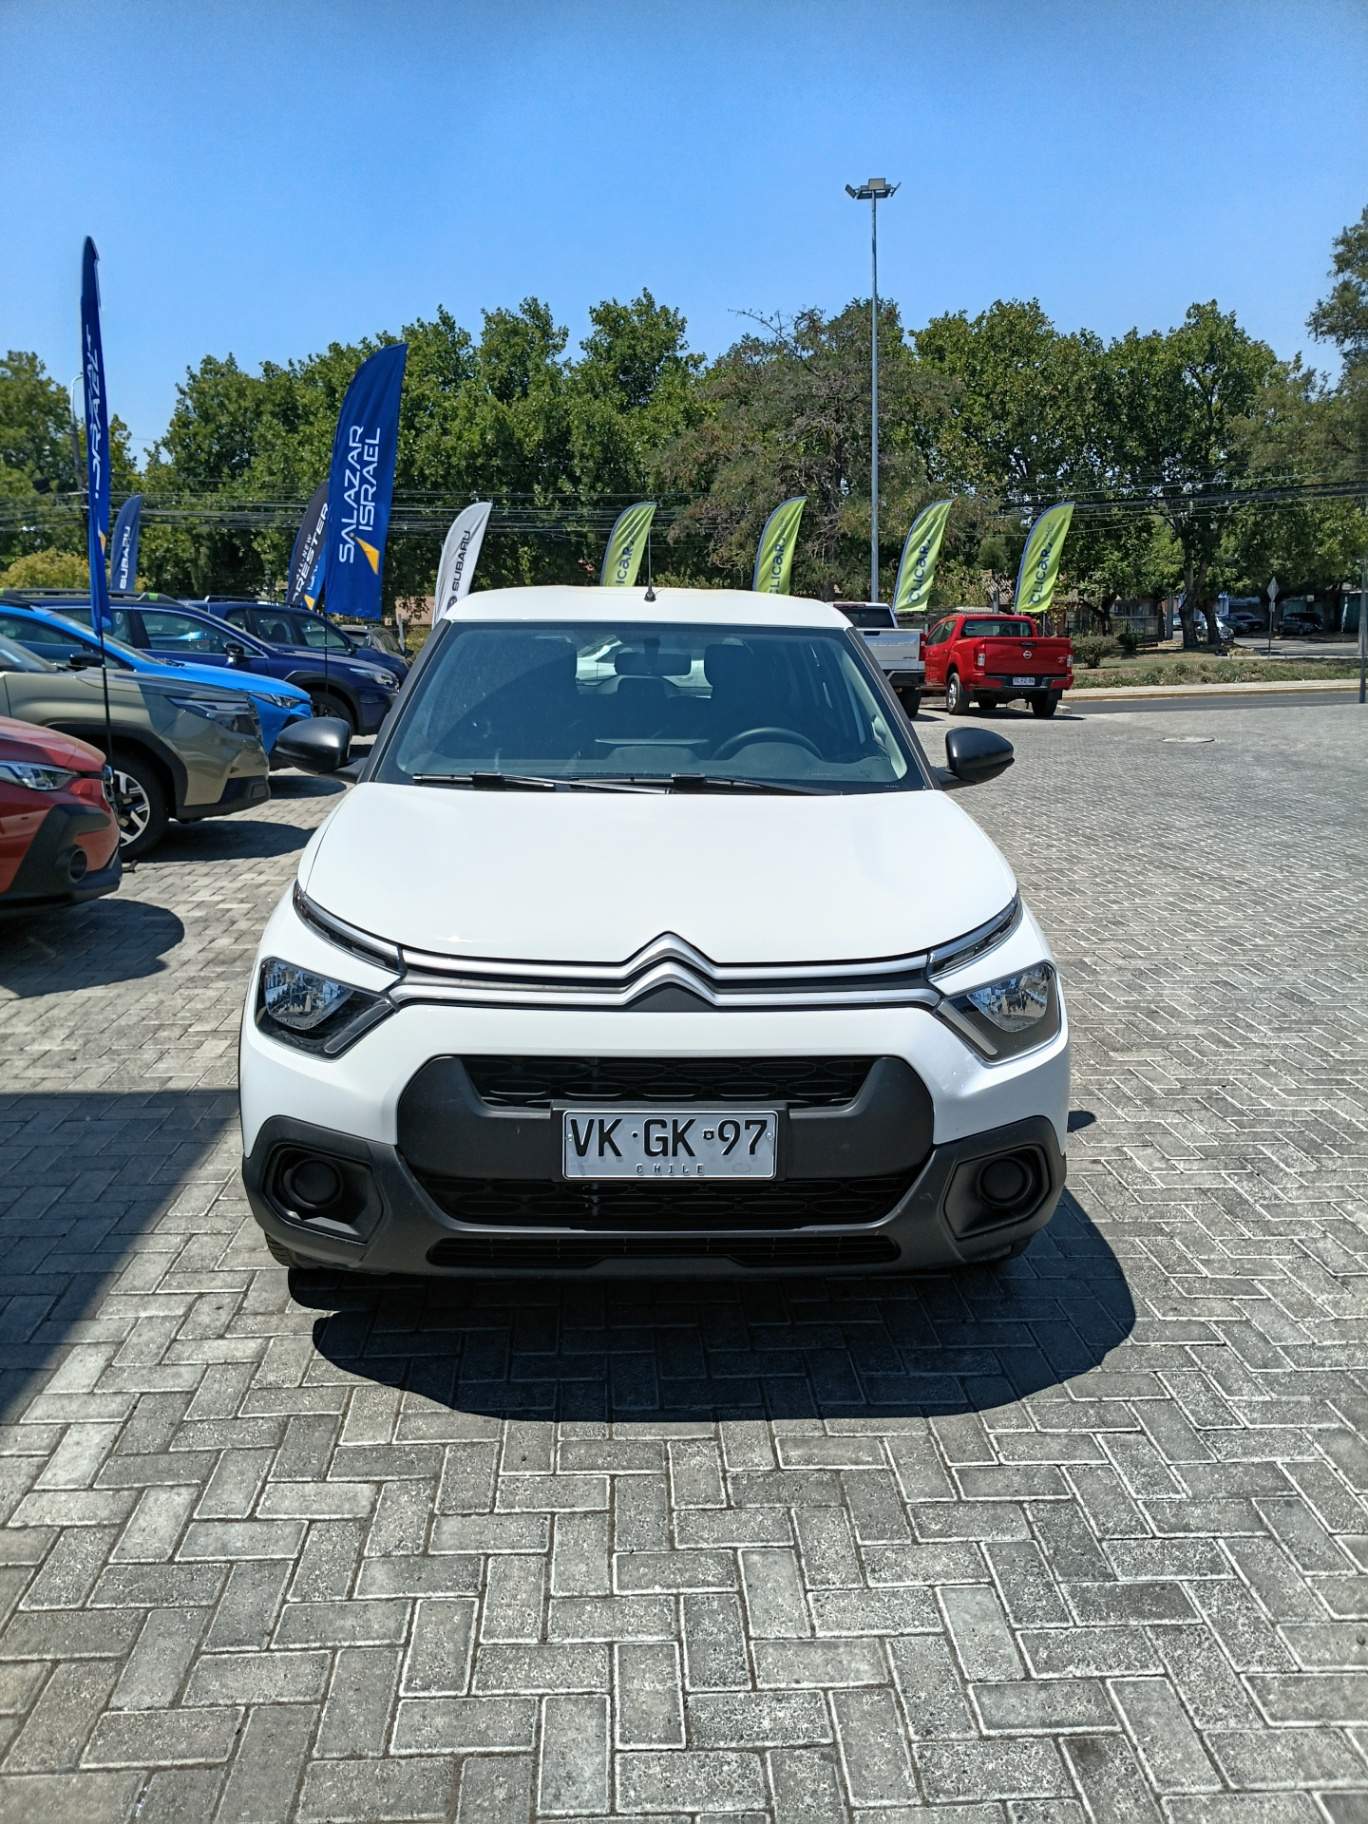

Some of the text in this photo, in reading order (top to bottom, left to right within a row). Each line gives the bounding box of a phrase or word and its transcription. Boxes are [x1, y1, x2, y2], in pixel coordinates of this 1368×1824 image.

[339, 425, 364, 563] SALAZAR
[358, 427, 381, 531] ISRAEL
[119, 525, 131, 590] SUBARU
[293, 502, 328, 601] RESTER
[451, 530, 471, 592] SUBARU
[635, 1163, 705, 1175] CHILE
